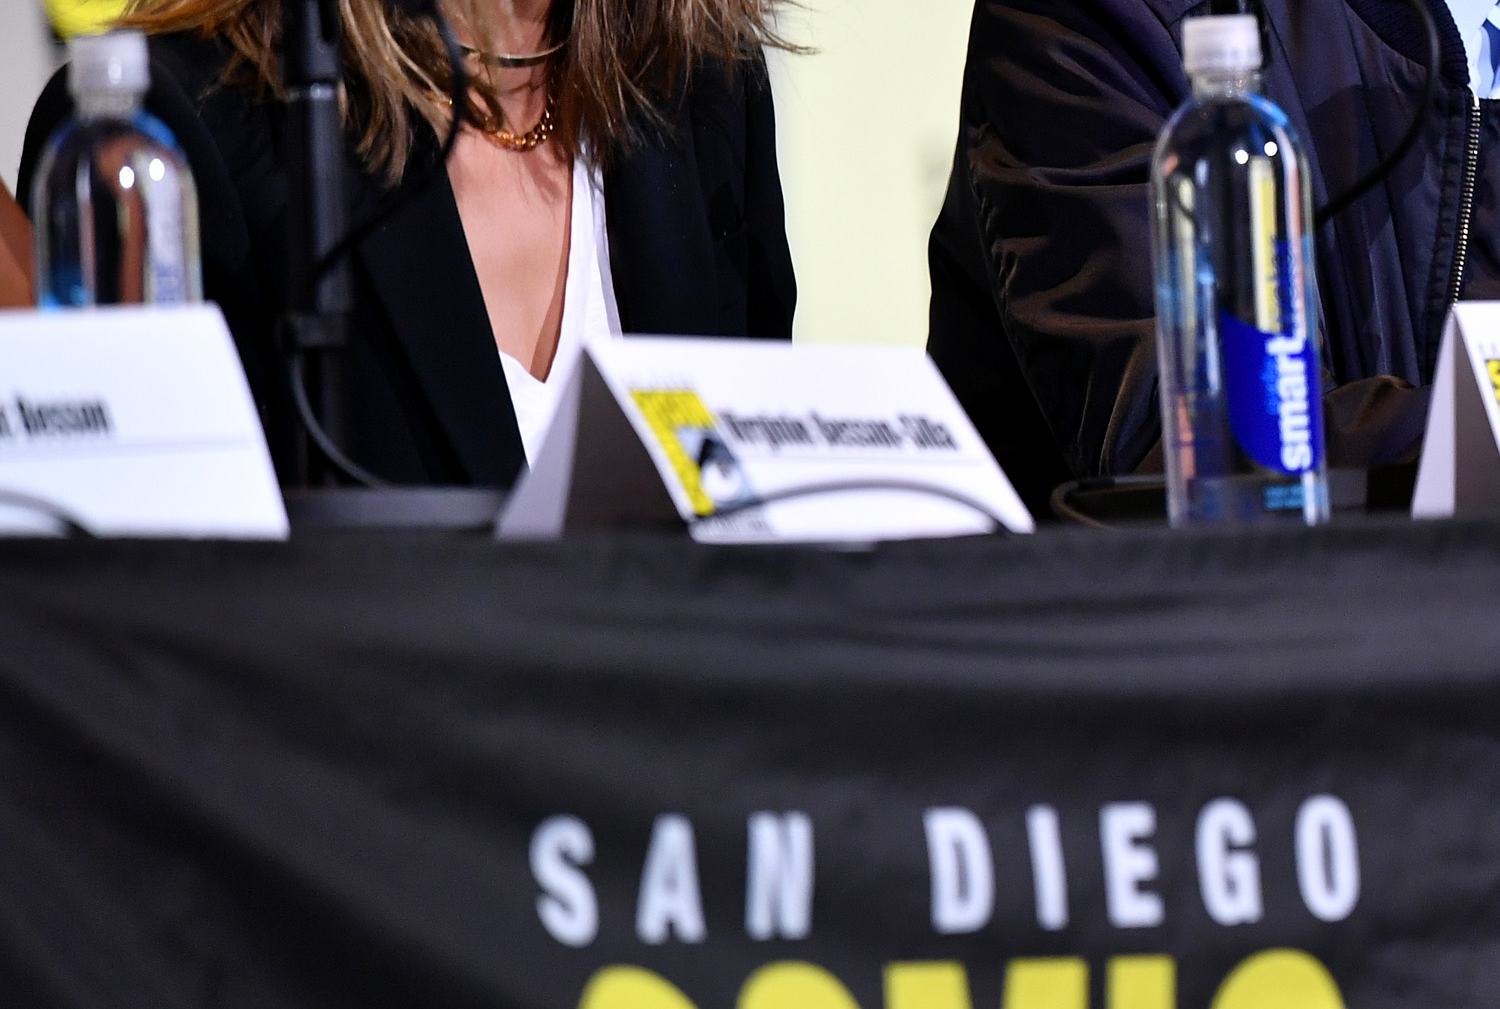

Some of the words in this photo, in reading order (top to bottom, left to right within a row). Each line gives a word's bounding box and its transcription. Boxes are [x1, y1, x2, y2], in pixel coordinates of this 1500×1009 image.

[1265, 335, 1314, 472] smart
[529, 812, 814, 947] SAN
[923, 794, 1361, 934] DIEGO
